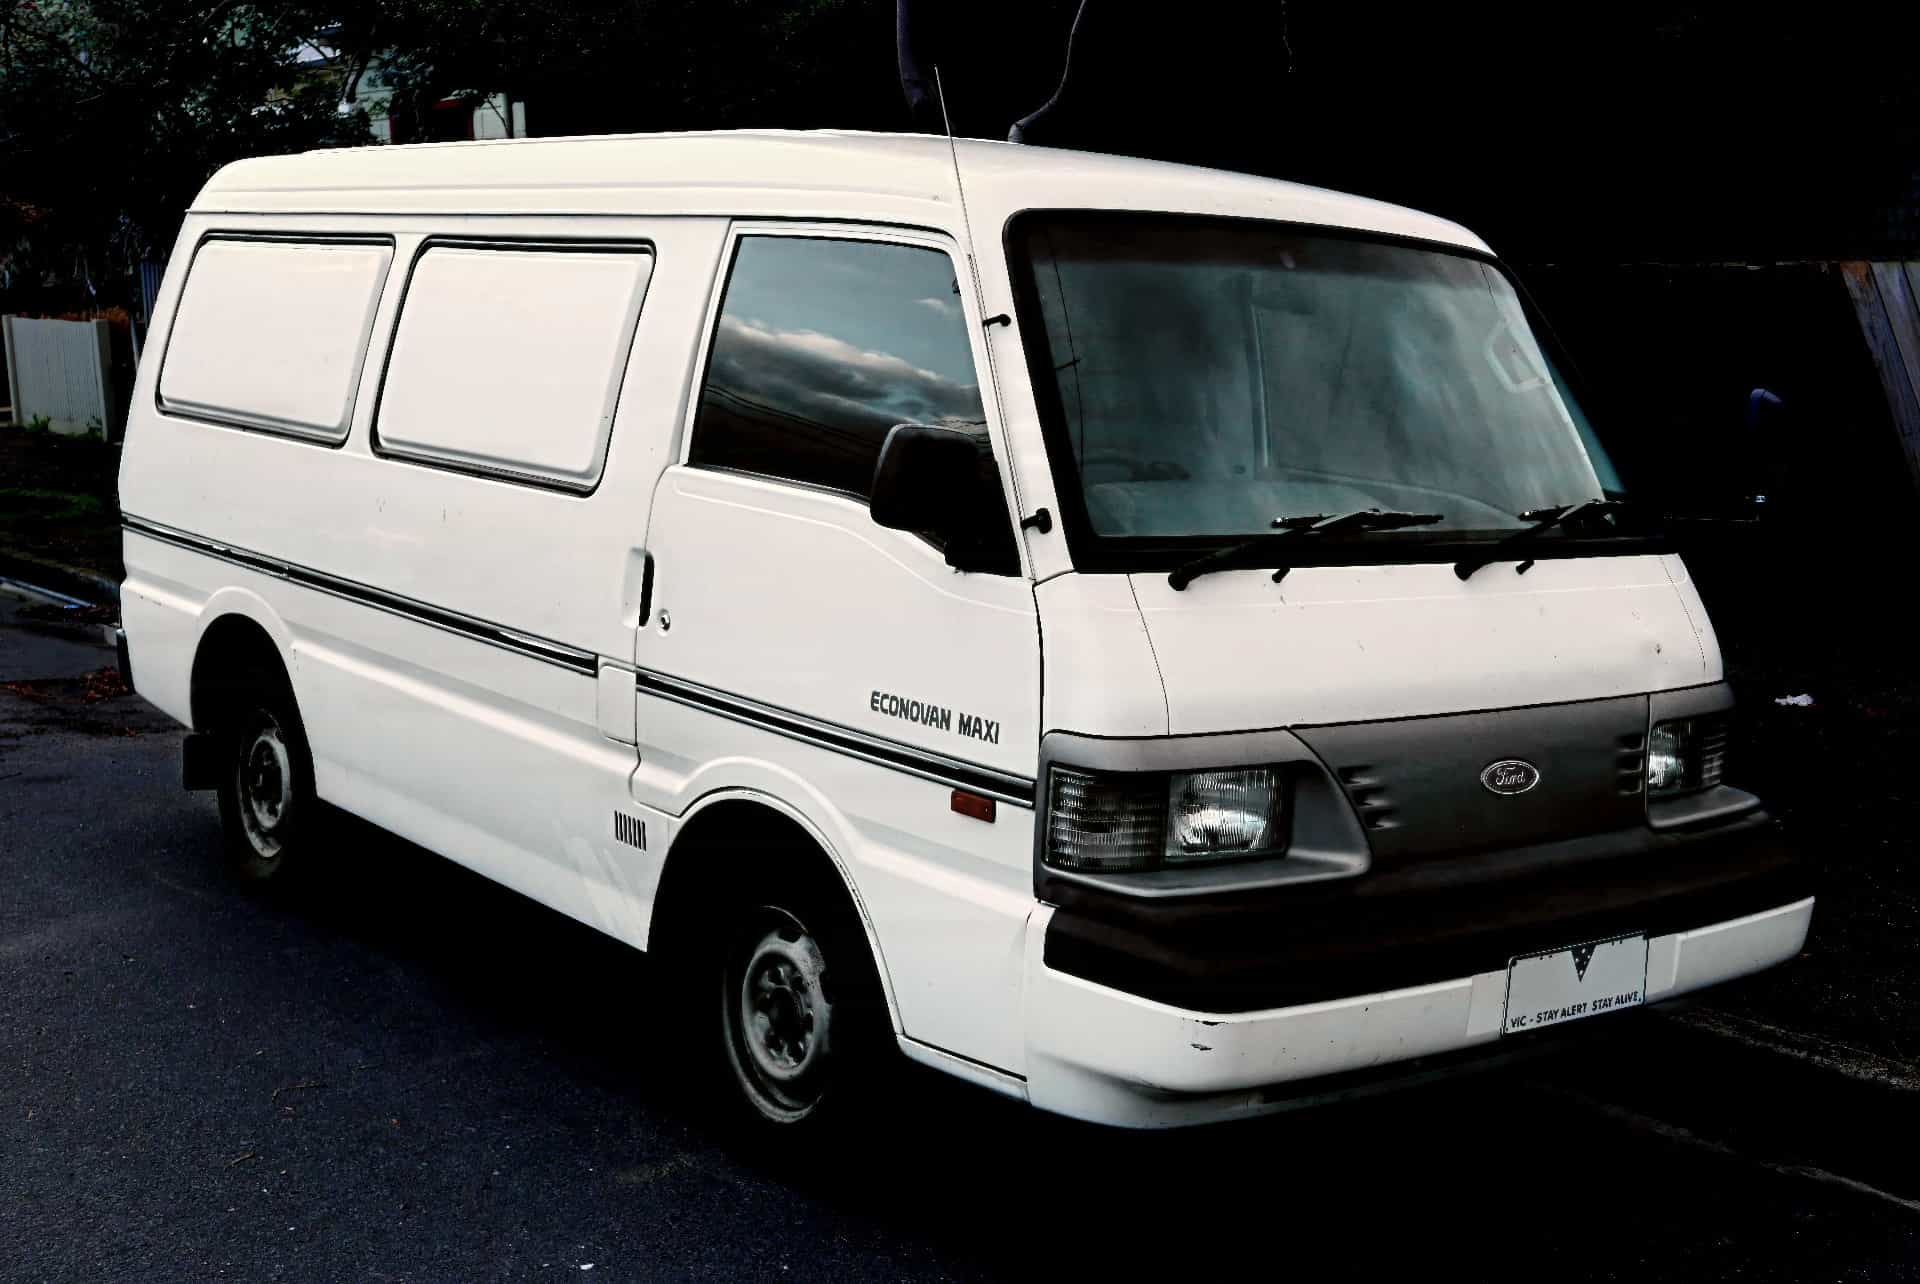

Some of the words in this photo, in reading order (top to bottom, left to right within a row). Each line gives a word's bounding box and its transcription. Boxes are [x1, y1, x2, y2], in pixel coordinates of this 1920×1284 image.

[870, 690, 952, 731] ECONOVAN
[958, 712, 1000, 745] MAXI
[1495, 766, 1526, 786] Ford
[1510, 1015, 1527, 1028] VIC
[1536, 1008, 1559, 1023] STAY
[1560, 1002, 1588, 1017] ALERT
[1591, 996, 1613, 1011] STAY
[1614, 991, 1639, 1006] ALIVE
